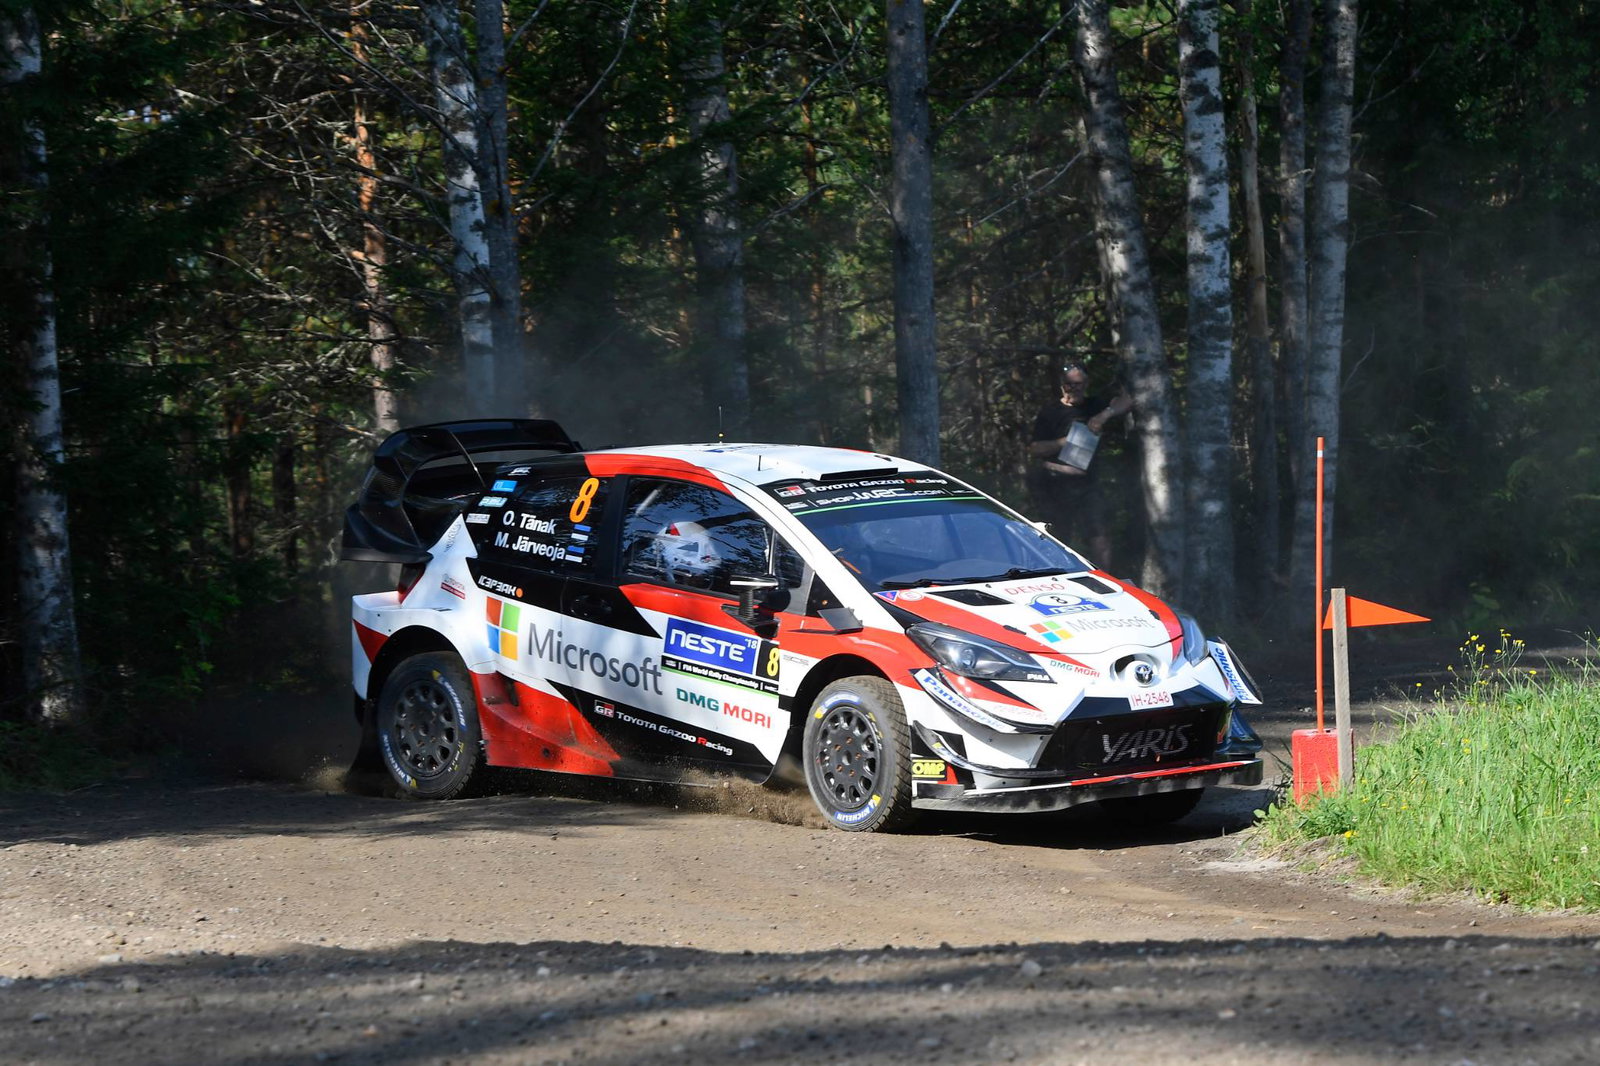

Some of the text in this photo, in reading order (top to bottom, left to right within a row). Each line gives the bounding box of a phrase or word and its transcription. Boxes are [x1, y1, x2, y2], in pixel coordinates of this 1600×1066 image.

[805, 483, 860, 493] TOYOTA
[859, 478, 905, 487] GAZOO
[569, 477, 600, 523] 8
[502, 510, 516, 527] O.
[494, 531, 510, 549] M.
[1004, 582, 1066, 596] DENSO
[1066, 616, 1156, 633] Microsoft
[670, 629, 746, 662] NESTE
[527, 621, 664, 696] Microsoft
[766, 647, 780, 677] 8
[1049, 660, 1101, 678] DMG MORI
[676, 687, 772, 729] DMG MORI
[1131, 692, 1170, 707] IH-2548
[594, 705, 733, 756] GR TOYOTA GAZOO Racing
[911, 762, 946, 775] OMP
[836, 806, 871, 822] MICHELIN
